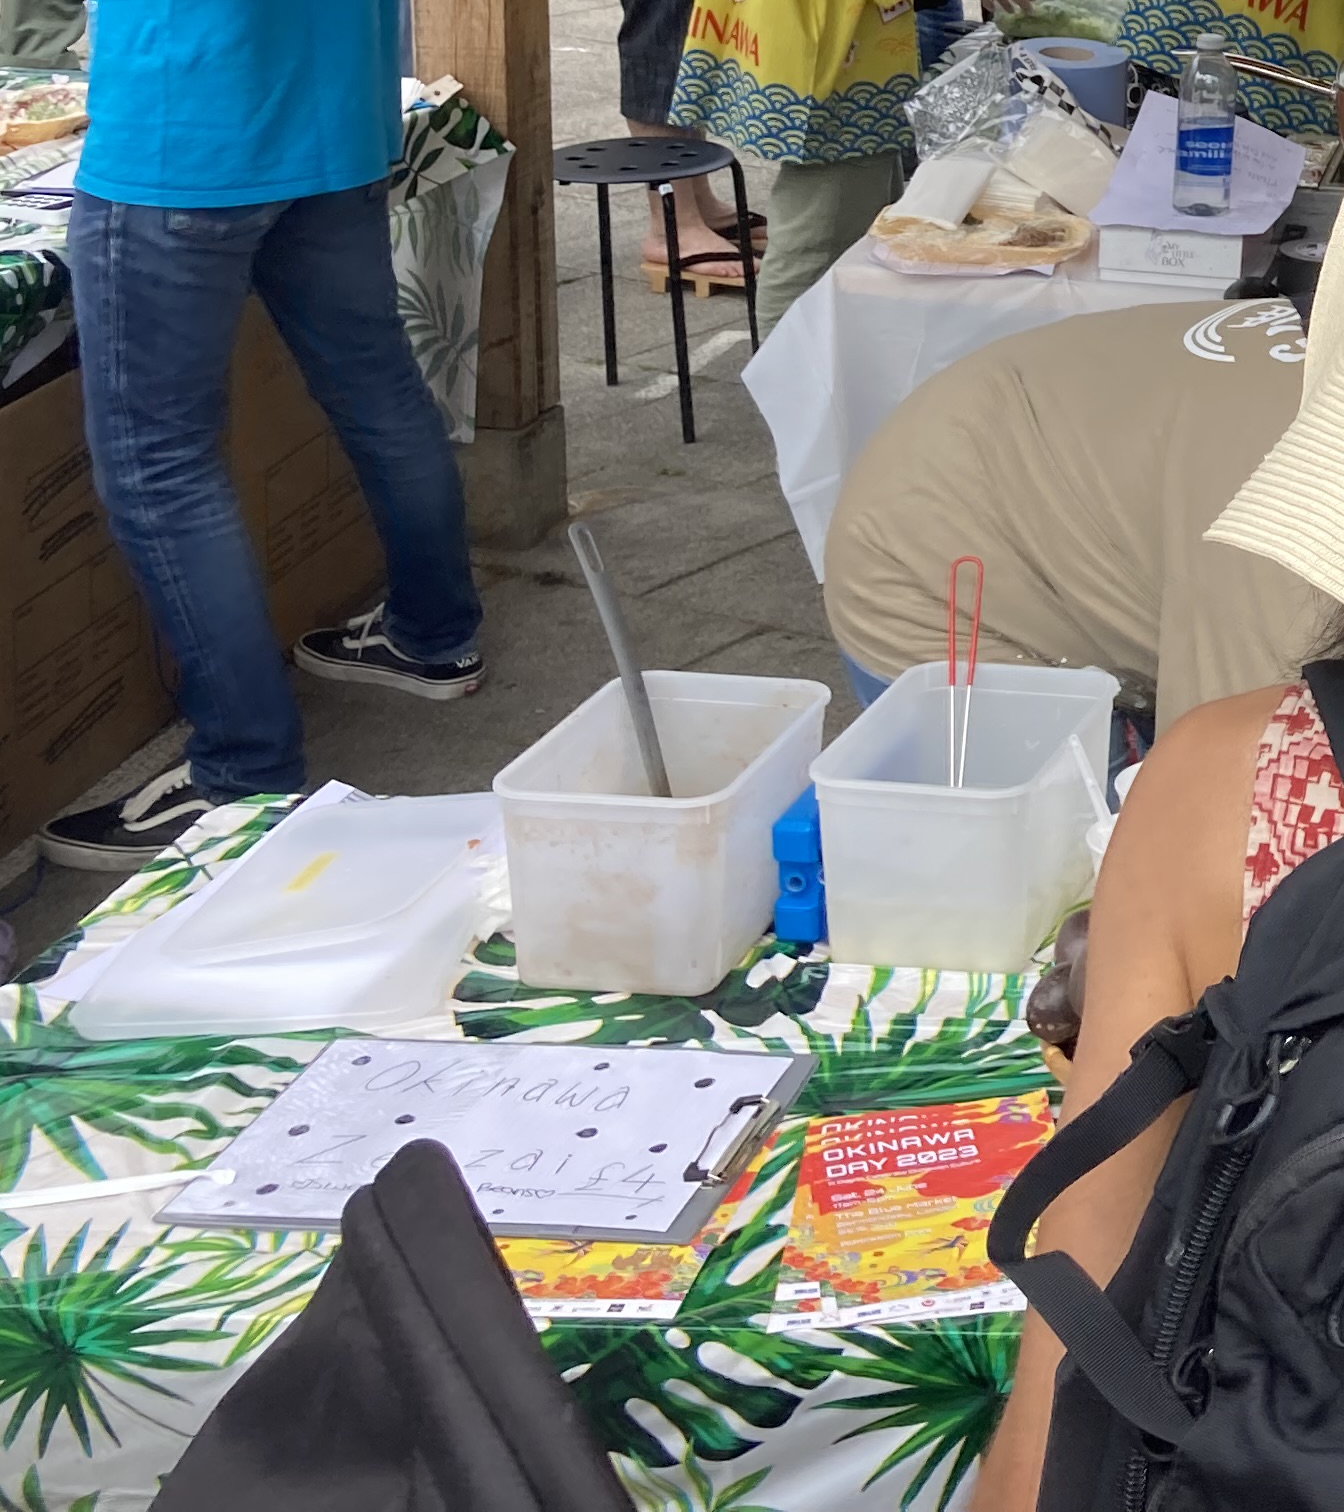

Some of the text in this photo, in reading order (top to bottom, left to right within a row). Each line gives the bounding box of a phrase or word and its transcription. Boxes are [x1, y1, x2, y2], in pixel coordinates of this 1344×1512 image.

[365, 1060, 631, 1112] Okinawa
[288, 1133, 573, 1175] Zezai
[823, 1128, 976, 1162] OKINAWA
[826, 1156, 888, 1179] DAY
[896, 1144, 979, 1168] 2023
[868, 1205, 902, 1215] Blue
[906, 1196, 958, 1208] Market
